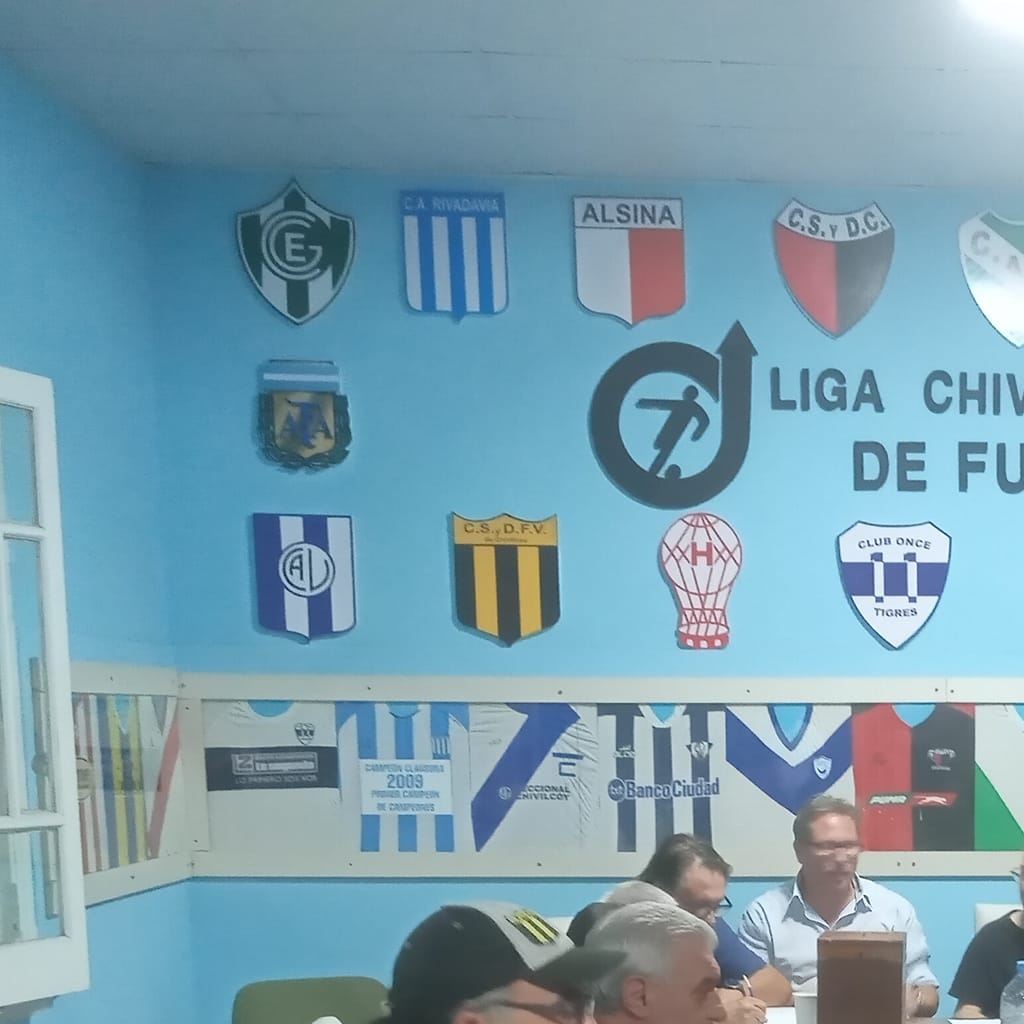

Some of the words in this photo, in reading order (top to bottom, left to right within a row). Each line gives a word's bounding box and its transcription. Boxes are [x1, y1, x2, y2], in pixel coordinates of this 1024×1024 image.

[581, 202, 676, 226] ALSINA
[769, 367, 885, 414] LIGA
[852, 440, 927, 493] DE
[857, 537, 892, 550] CLUB
[896, 536, 932, 551] ONCE
[873, 606, 919, 618] TIGRES
[386, 773, 425, 790] 2009
